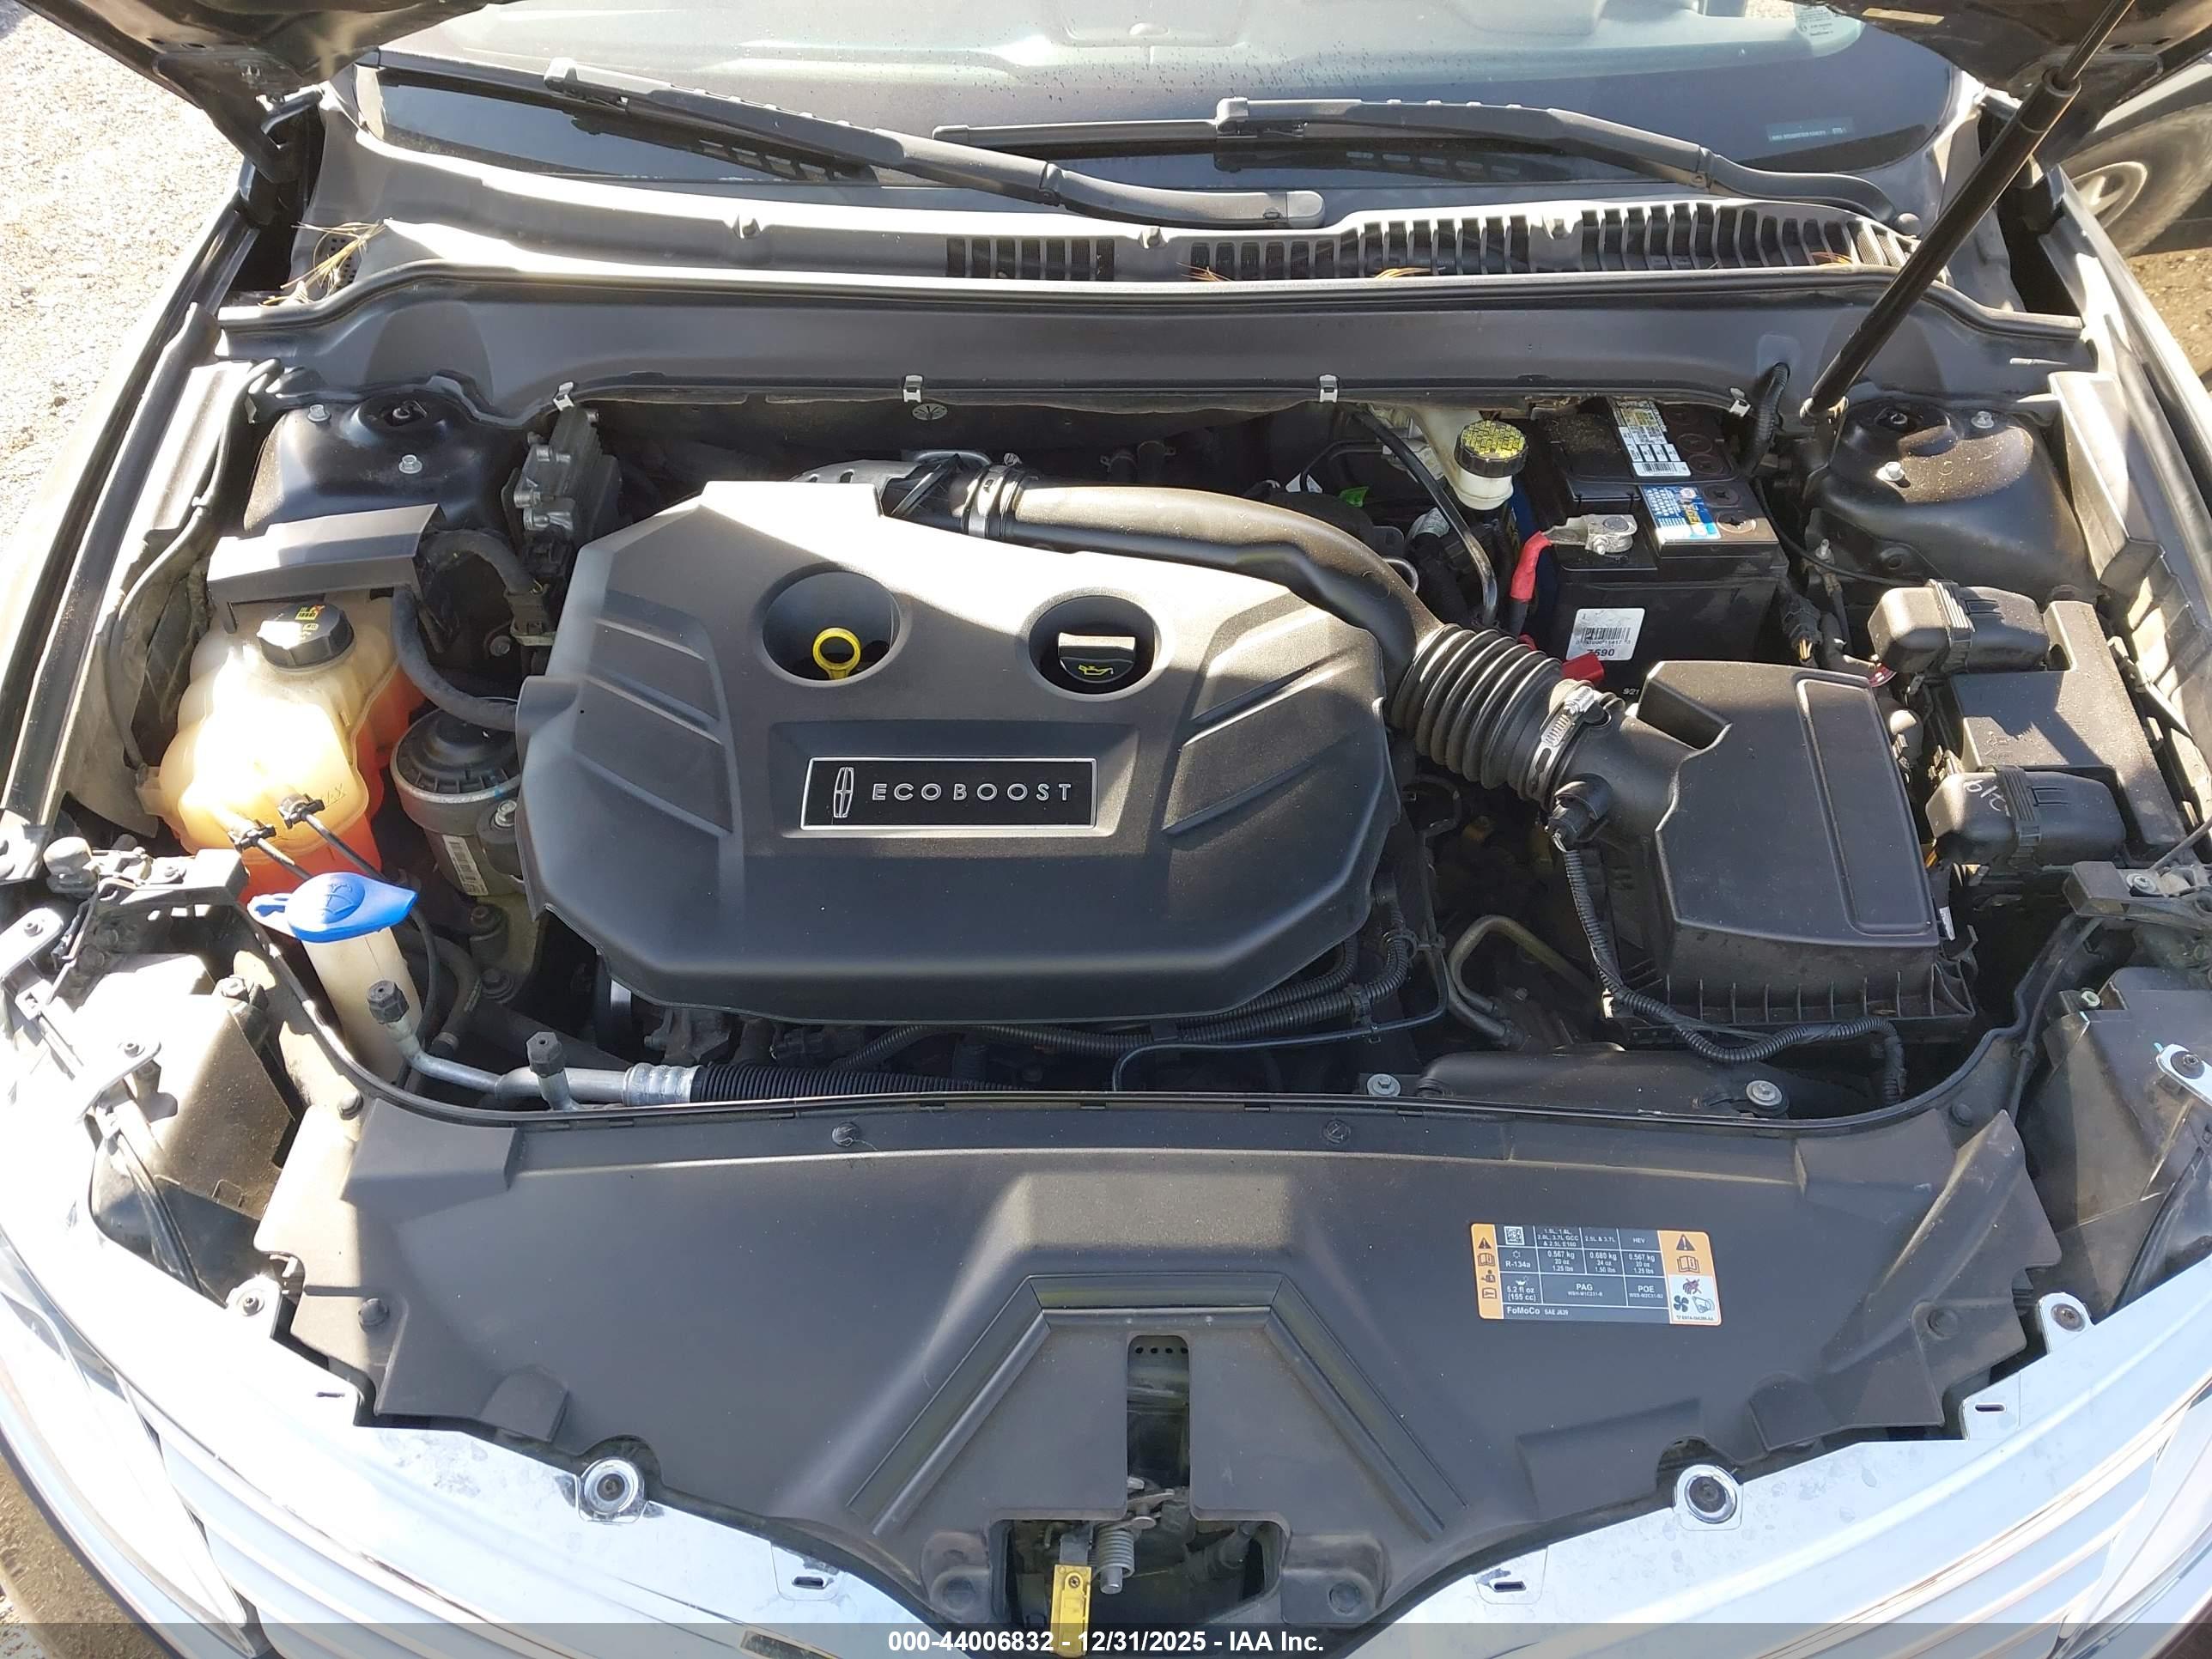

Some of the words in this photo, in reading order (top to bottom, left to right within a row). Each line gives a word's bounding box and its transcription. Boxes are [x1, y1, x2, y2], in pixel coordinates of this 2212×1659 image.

[872, 783, 1072, 801] ECOBOOST
[1566, 1250, 1575, 1259] kg
[1608, 1252, 1617, 1261] kg
[1647, 1254, 1655, 1262] kg
